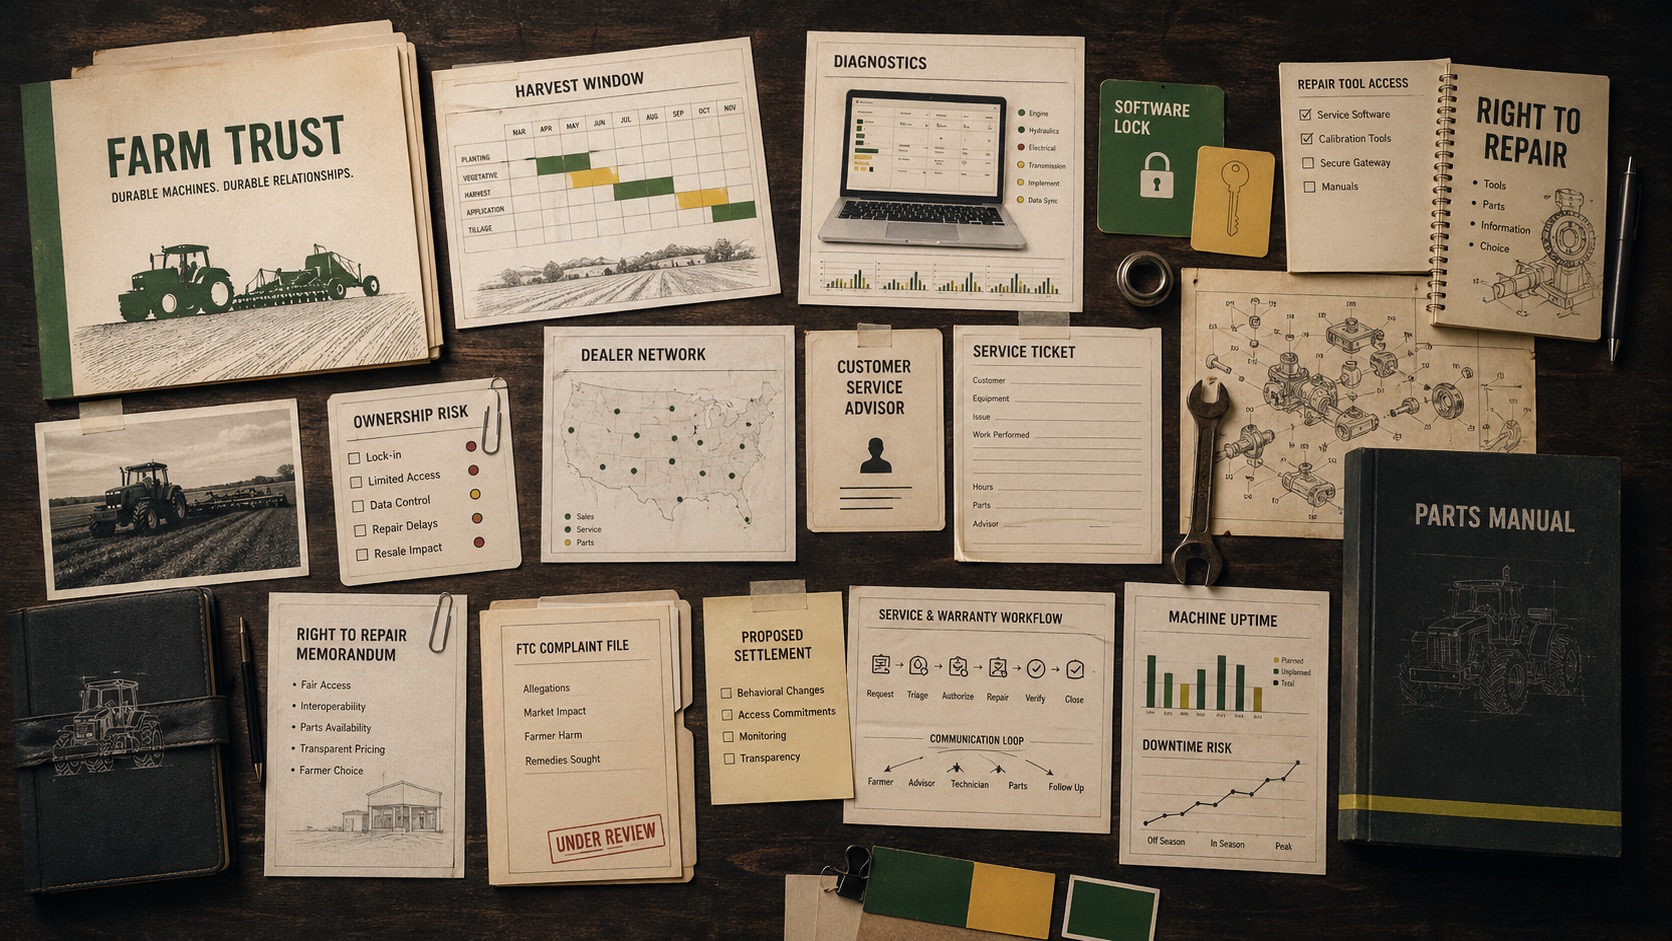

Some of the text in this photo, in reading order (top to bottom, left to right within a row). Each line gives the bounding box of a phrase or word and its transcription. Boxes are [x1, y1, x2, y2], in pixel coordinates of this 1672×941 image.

[834, 55, 927, 70] DIAGNOSTICS
[516, 71, 643, 98] HARVEST WINDOW
[1298, 78, 1408, 90] REPAIR TOOL ACCESS
[673, 110, 684, 118] SEP
[1029, 110, 1048, 118] Engine
[1115, 100, 1190, 117] SOFTWARE
[1317, 109, 1390, 119] Service Software
[1477, 96, 1581, 134] RIGHT TO
[512, 128, 526, 136] MAR
[1029, 127, 1059, 135] Hydraulics
[1115, 119, 1150, 135] LOCK
[1319, 134, 1392, 143] Calibration Tools
[107, 114, 344, 178] FARM TRUST
[1484, 133, 1567, 168] REPAIR
[1320, 158, 1391, 169] Secure Gateway
[112, 168, 353, 203] DURABLE MACHINES. DURABLE RELATIONSHIPS.
[1322, 182, 1359, 191] Manuals
[1484, 179, 1506, 190] Tools
[1043, 197, 1058, 205] Sync
[1483, 200, 1505, 211] Parts
[466, 206, 505, 216] APPLICATION
[1481, 220, 1531, 235] Information
[1480, 241, 1510, 253] Choice
[582, 348, 706, 361] DEALER NETWORK
[973, 345, 1076, 358] SERVICE TICKET
[838, 360, 911, 373] CUSTOMER
[972, 376, 1006, 384] Customer
[847, 380, 903, 394] SERVICE
[973, 394, 1009, 403] Equipment
[845, 401, 904, 415] ADVISOR
[354, 404, 468, 428] OWNERSHIP RISK
[366, 450, 401, 462] Lock-in
[368, 472, 441, 486] Limited Access
[973, 483, 993, 491] Hours
[370, 495, 430, 510] Data Control
[973, 501, 991, 509] Parts
[1416, 503, 1575, 533] PARTS MANUAL
[372, 520, 438, 535] Repair Delays
[973, 520, 999, 528] Advisor
[374, 543, 442, 558] Resale Impact
[879, 609, 1063, 624] SERVICE & WARRANTY WORKFLOW
[1169, 610, 1277, 627] MACHINE UPTIME
[297, 628, 406, 642] RIGHT TO REPAIR
[742, 629, 803, 643] PROPOSED
[517, 639, 629, 655] FTC COMPLAINT FILE
[297, 647, 395, 661] MEMORANDUM
[734, 647, 812, 662] SETTLEMENT
[301, 680, 351, 690] Fair Access
[523, 684, 570, 695] Allegations
[737, 686, 825, 697] Behavioral Changes
[867, 689, 894, 699] Request
[907, 690, 928, 701] Triage
[942, 692, 974, 700] Authorize
[987, 693, 1009, 703] Repair
[1025, 694, 1046, 704] Verify
[1065, 695, 1084, 704] Close
[301, 701, 366, 713] Interoperability
[524, 707, 586, 718] Market Impact
[738, 708, 836, 719] Access Commitments
[300, 722, 371, 734] Parts Availability
[525, 731, 582, 741] Farmer Harm
[739, 730, 786, 742] Monitoring
[930, 734, 1024, 745] COMMUNICATION LOOP
[300, 744, 385, 756] Transparent Pricing
[1143, 739, 1232, 754] DOWNTIME RISK
[525, 754, 600, 766] Remedies Sought
[740, 754, 800, 764] Transparency
[300, 765, 363, 775] Farmer Choice
[868, 777, 894, 786] Farmer
[908, 779, 935, 787] Advisor
[951, 779, 989, 789] Technician
[1009, 781, 1028, 790] Parts
[1049, 782, 1084, 794] Follow Up
[555, 822, 657, 853] UNDER REVIEW
[1160, 836, 1185, 846] Season
[1211, 839, 1245, 848] In Season
[1275, 842, 1292, 851] Peak
